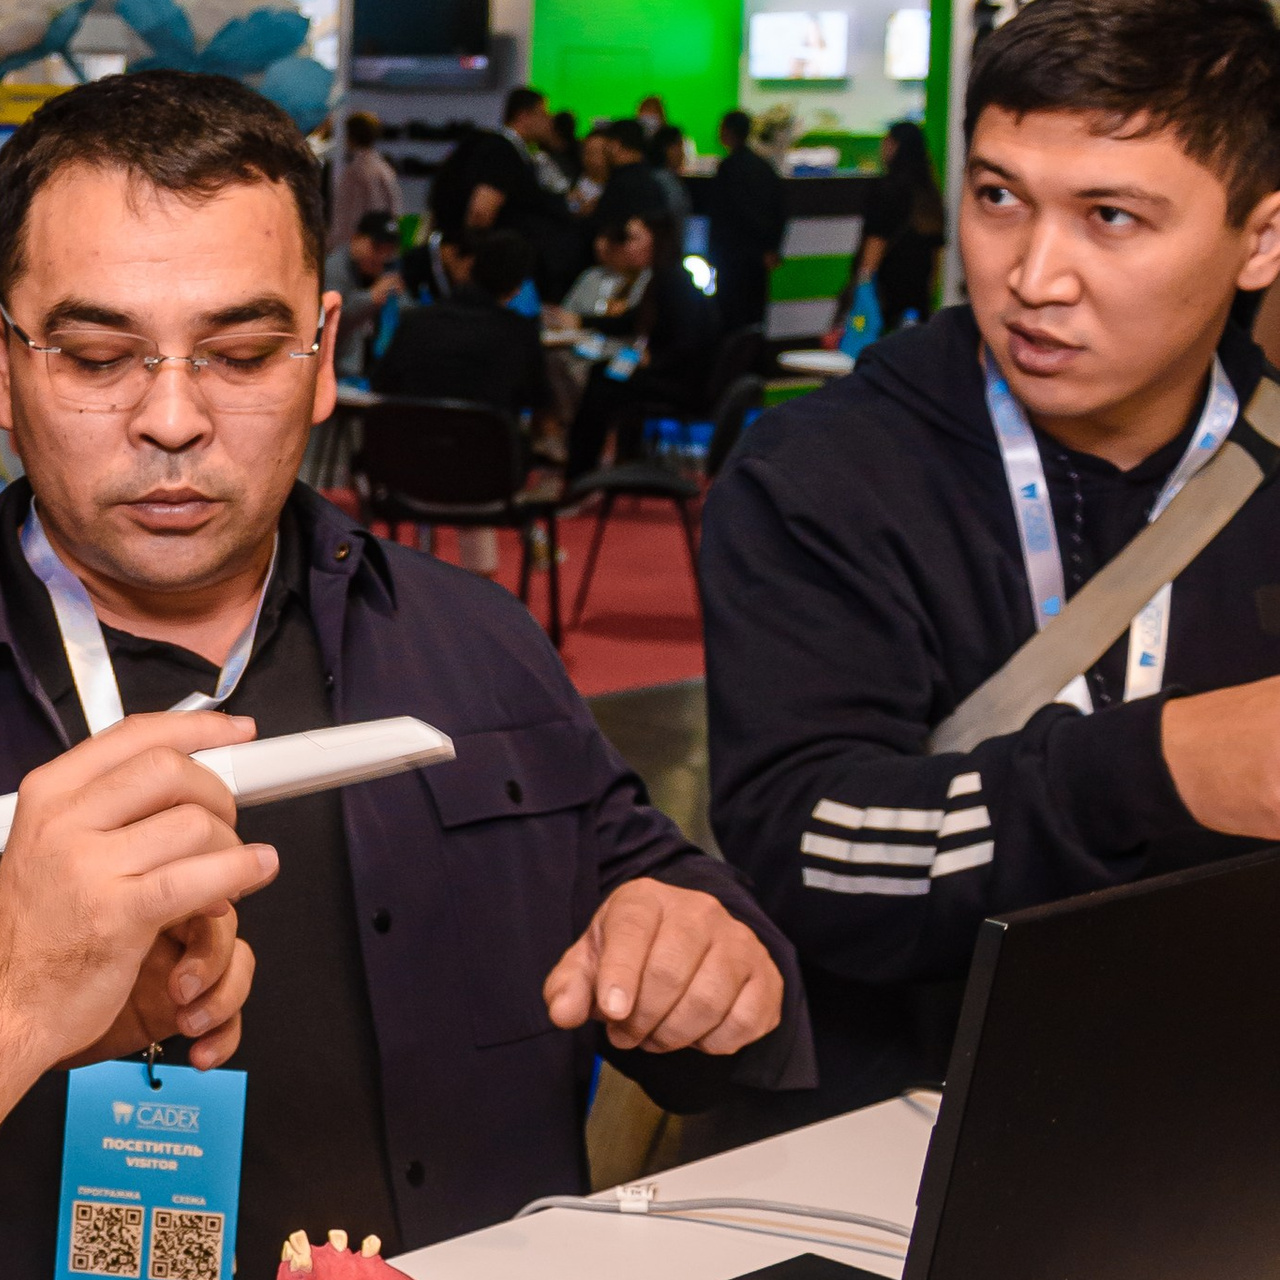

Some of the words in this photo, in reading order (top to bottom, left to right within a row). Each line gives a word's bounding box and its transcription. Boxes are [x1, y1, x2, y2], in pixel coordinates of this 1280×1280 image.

[136, 1106, 200, 1130] CADEX
[102, 1136, 204, 1158] ПОСЕТИТЕЛЬ
[125, 1156, 179, 1171] VISITOR
